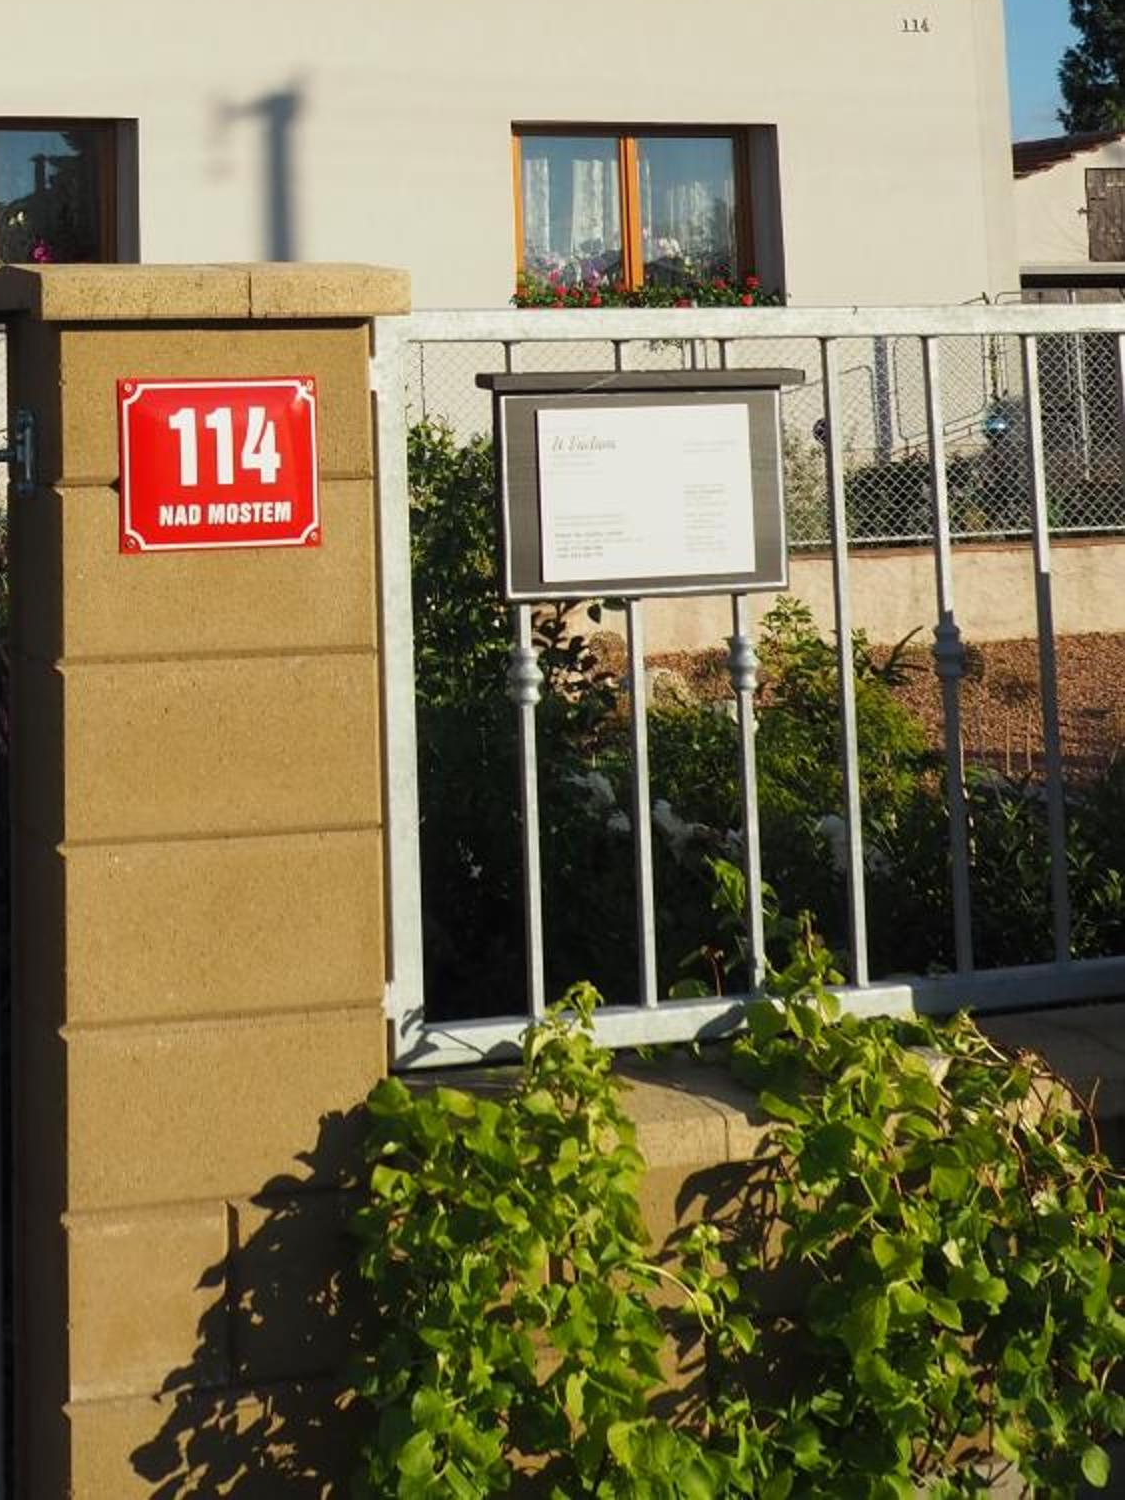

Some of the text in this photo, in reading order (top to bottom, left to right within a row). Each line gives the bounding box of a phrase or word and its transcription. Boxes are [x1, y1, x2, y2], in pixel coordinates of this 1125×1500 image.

[902, 18, 929, 32] 114
[169, 407, 281, 485] 114
[160, 502, 292, 526] NAD MOSTEM
